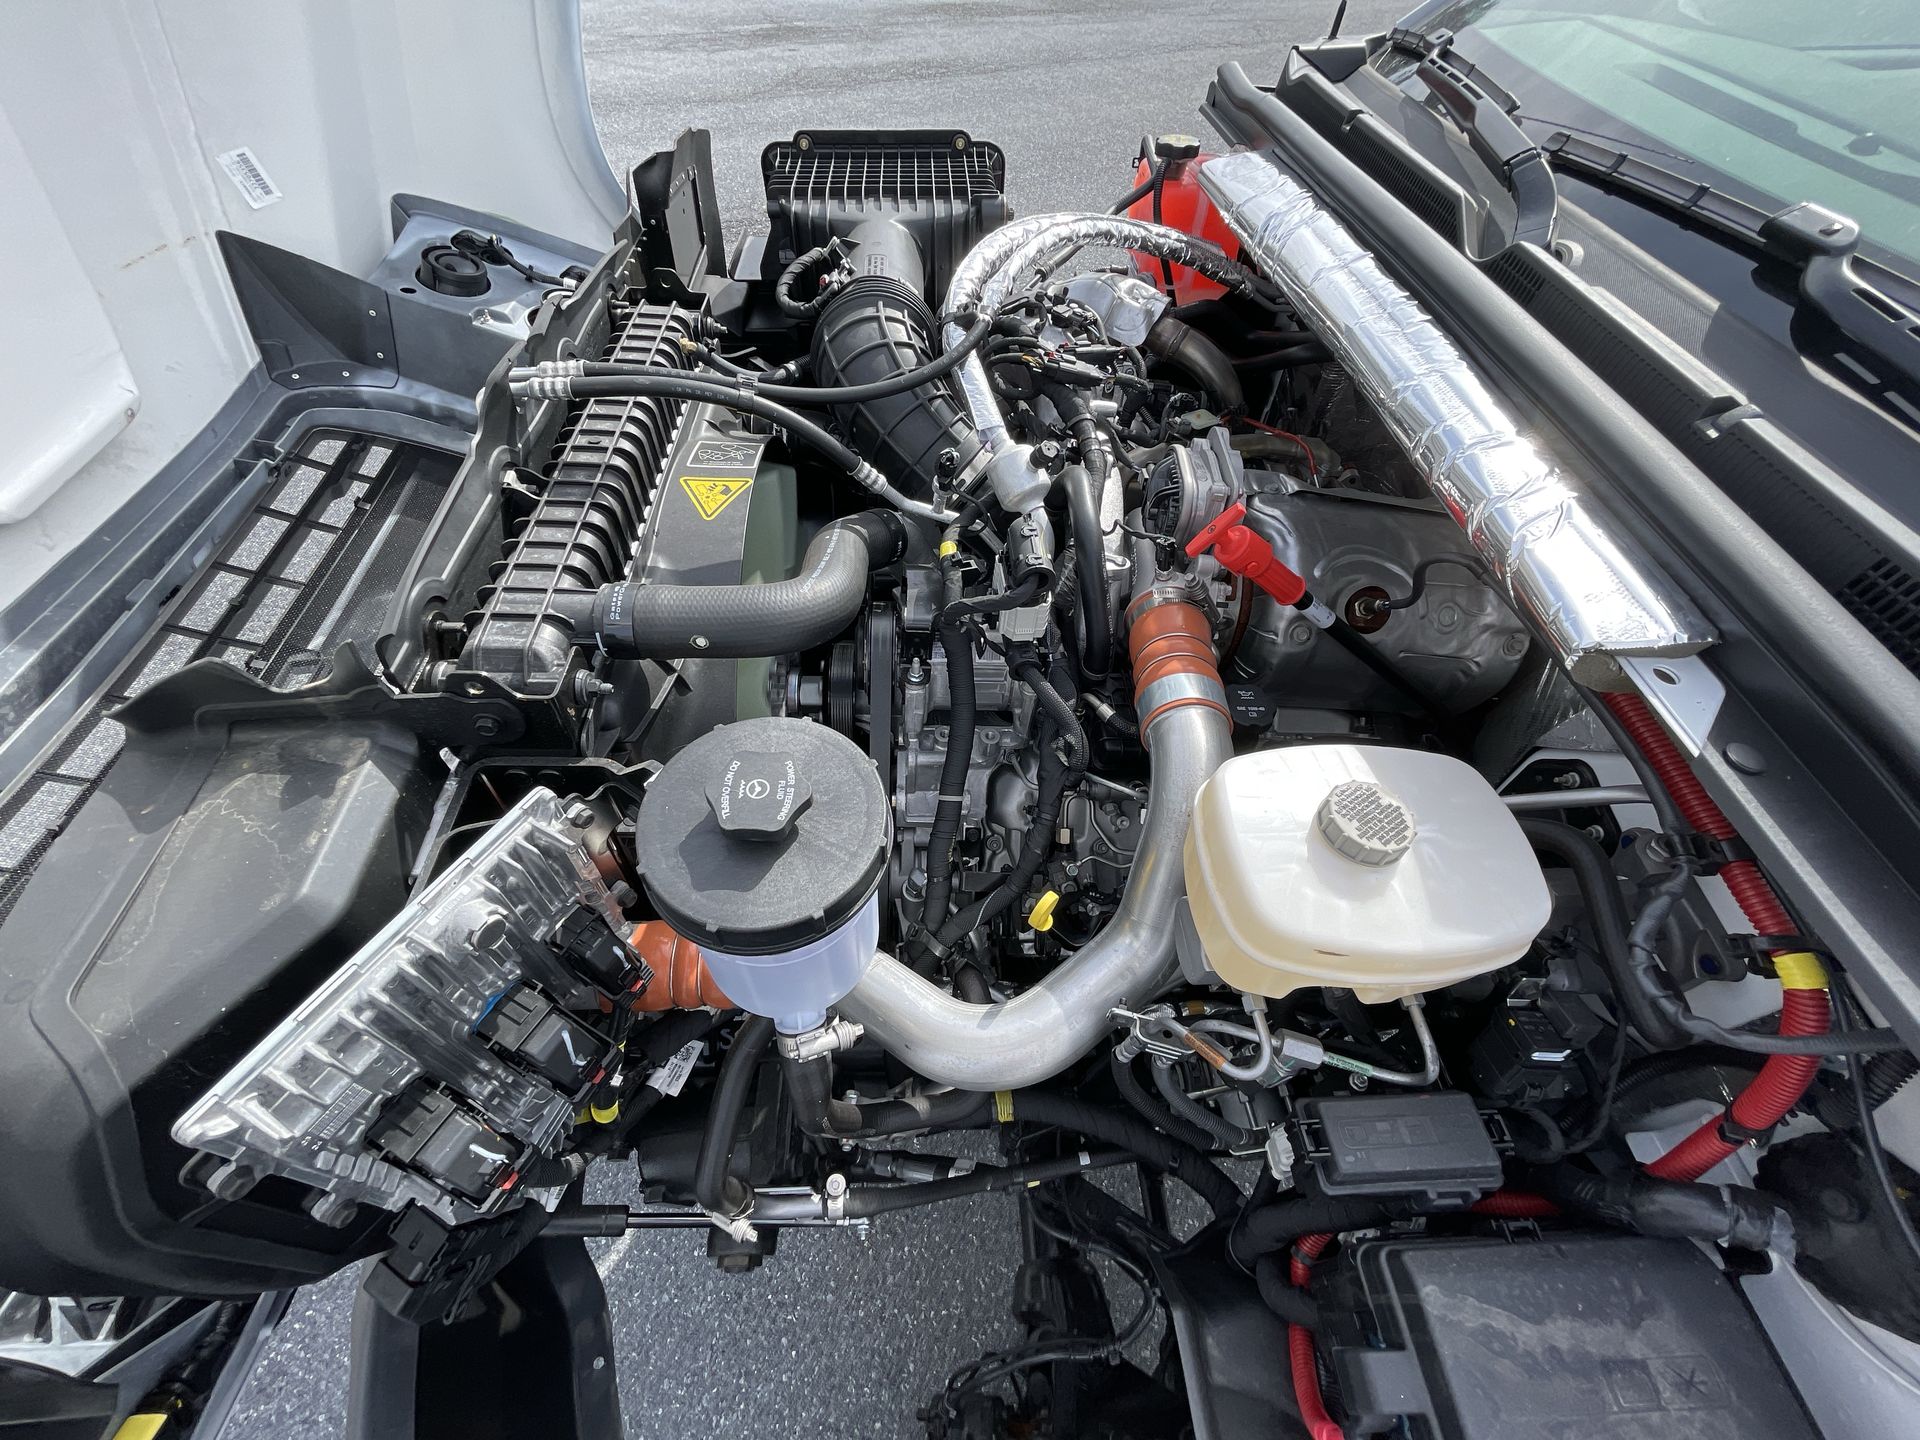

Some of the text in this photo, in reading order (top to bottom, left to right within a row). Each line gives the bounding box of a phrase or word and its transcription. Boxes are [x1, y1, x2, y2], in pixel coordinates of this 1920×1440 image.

[720, 760, 741, 820] DO NOT OVERFILL
[776, 780, 786, 800] FLUID
[777, 760, 796, 821] POWER STEERING
